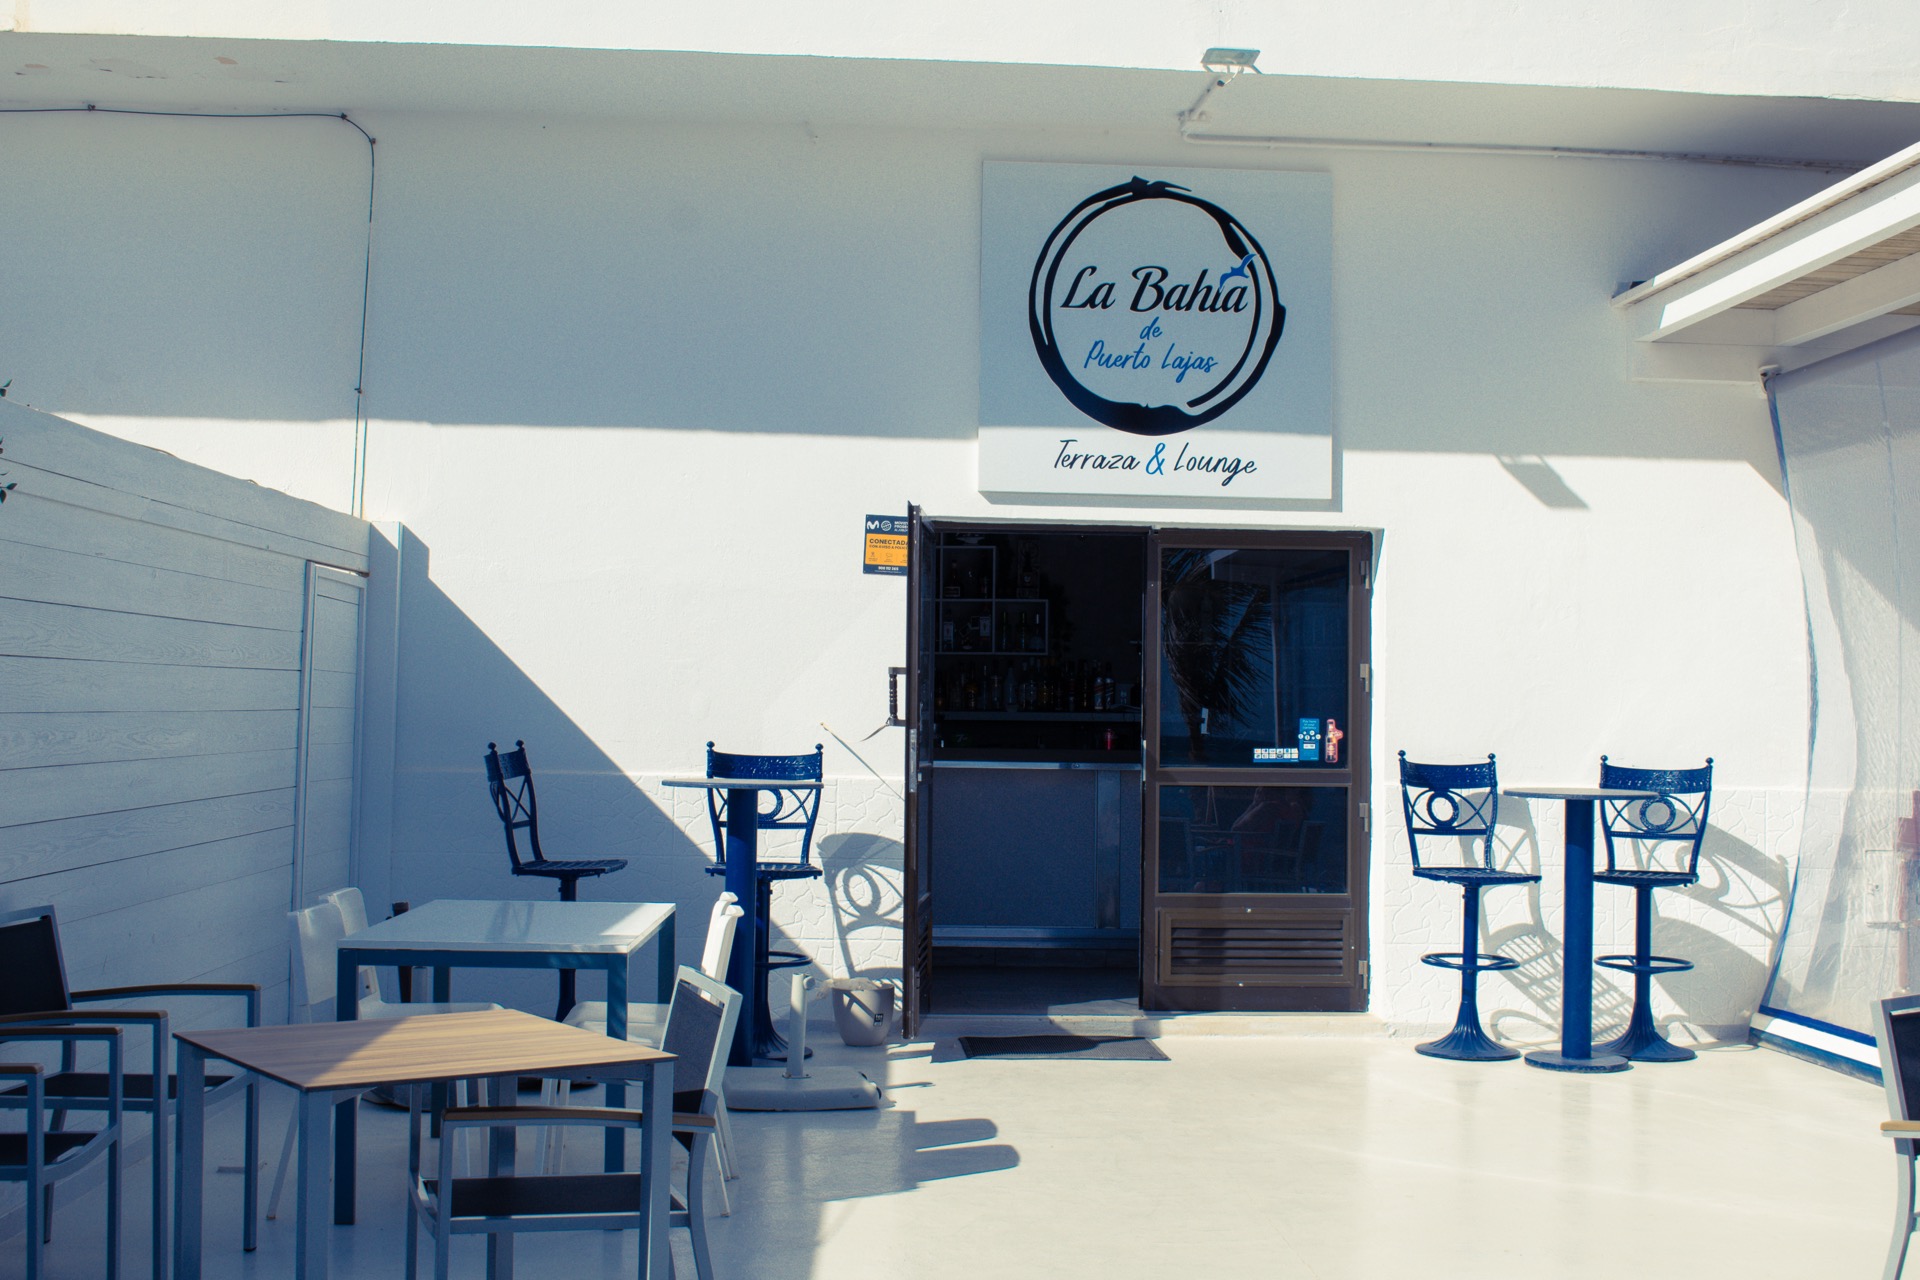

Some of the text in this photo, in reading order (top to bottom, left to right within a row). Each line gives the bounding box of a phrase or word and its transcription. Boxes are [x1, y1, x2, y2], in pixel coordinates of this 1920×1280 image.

[1060, 265, 1116, 310] La
[1139, 316, 1163, 340] de
[1083, 339, 1219, 384] Puerto Lajas
[1053, 438, 1258, 487] Terraza & Lounge
